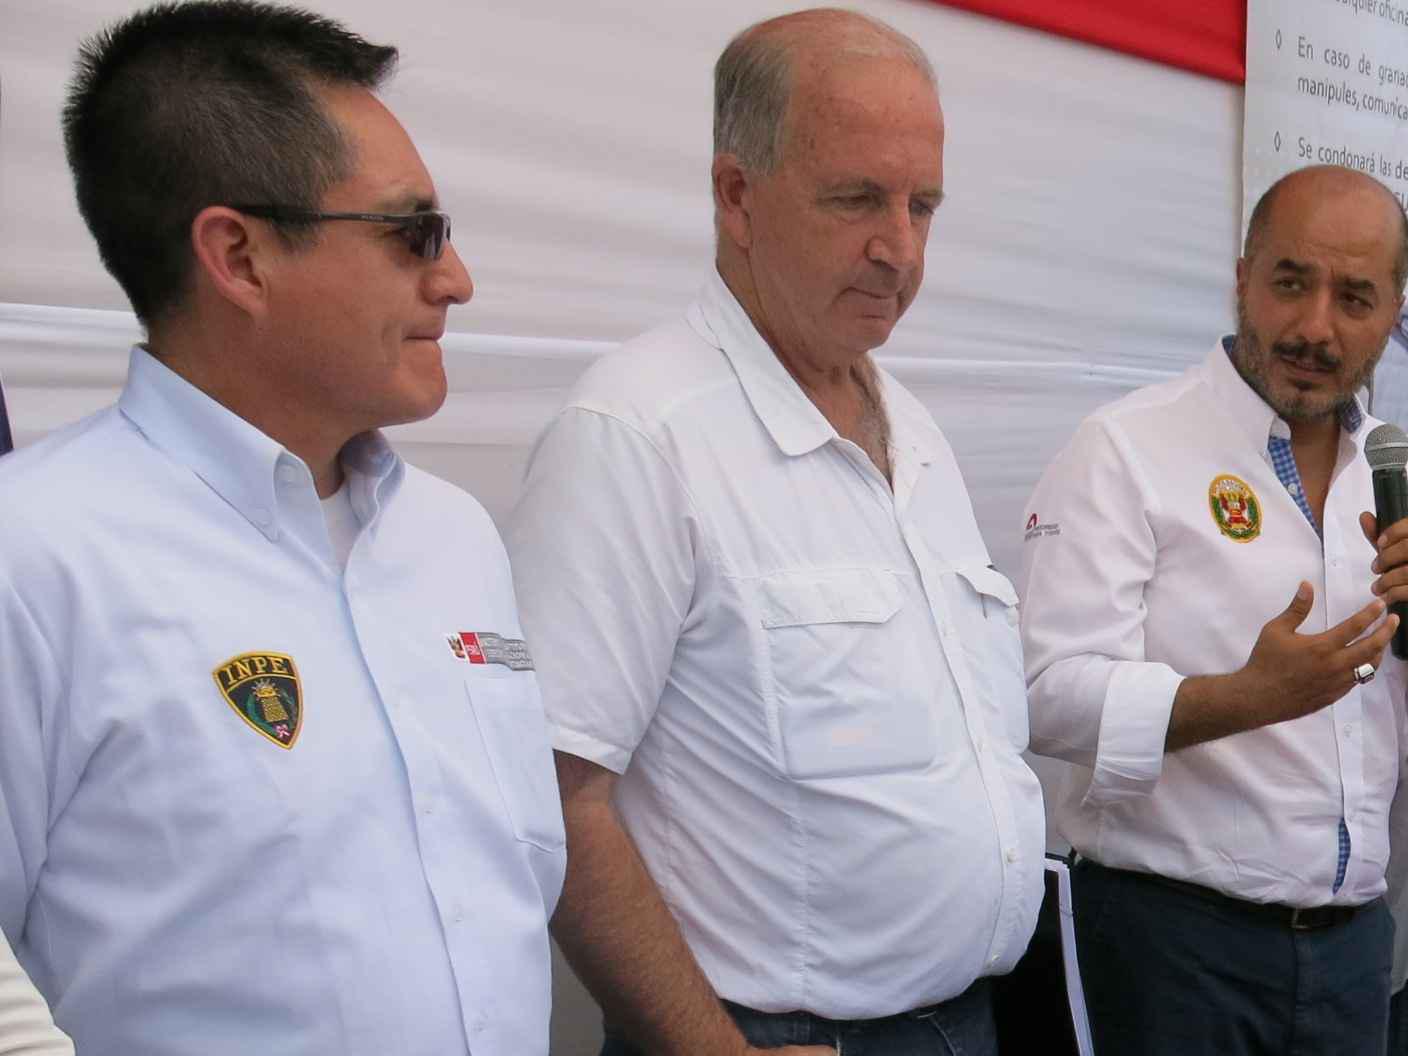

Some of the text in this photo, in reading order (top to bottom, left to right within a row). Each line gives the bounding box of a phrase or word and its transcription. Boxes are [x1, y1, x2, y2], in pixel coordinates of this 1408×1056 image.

[1297, 35, 1313, 60] En
[1323, 48, 1350, 70] caso
[1357, 53, 1371, 76] de
[1297, 77, 1359, 110] manipules,
[1298, 136, 1313, 159] Se
[1317, 146, 1375, 174] condonará
[1379, 154, 1391, 177] las
[224, 655, 296, 687] INPE
